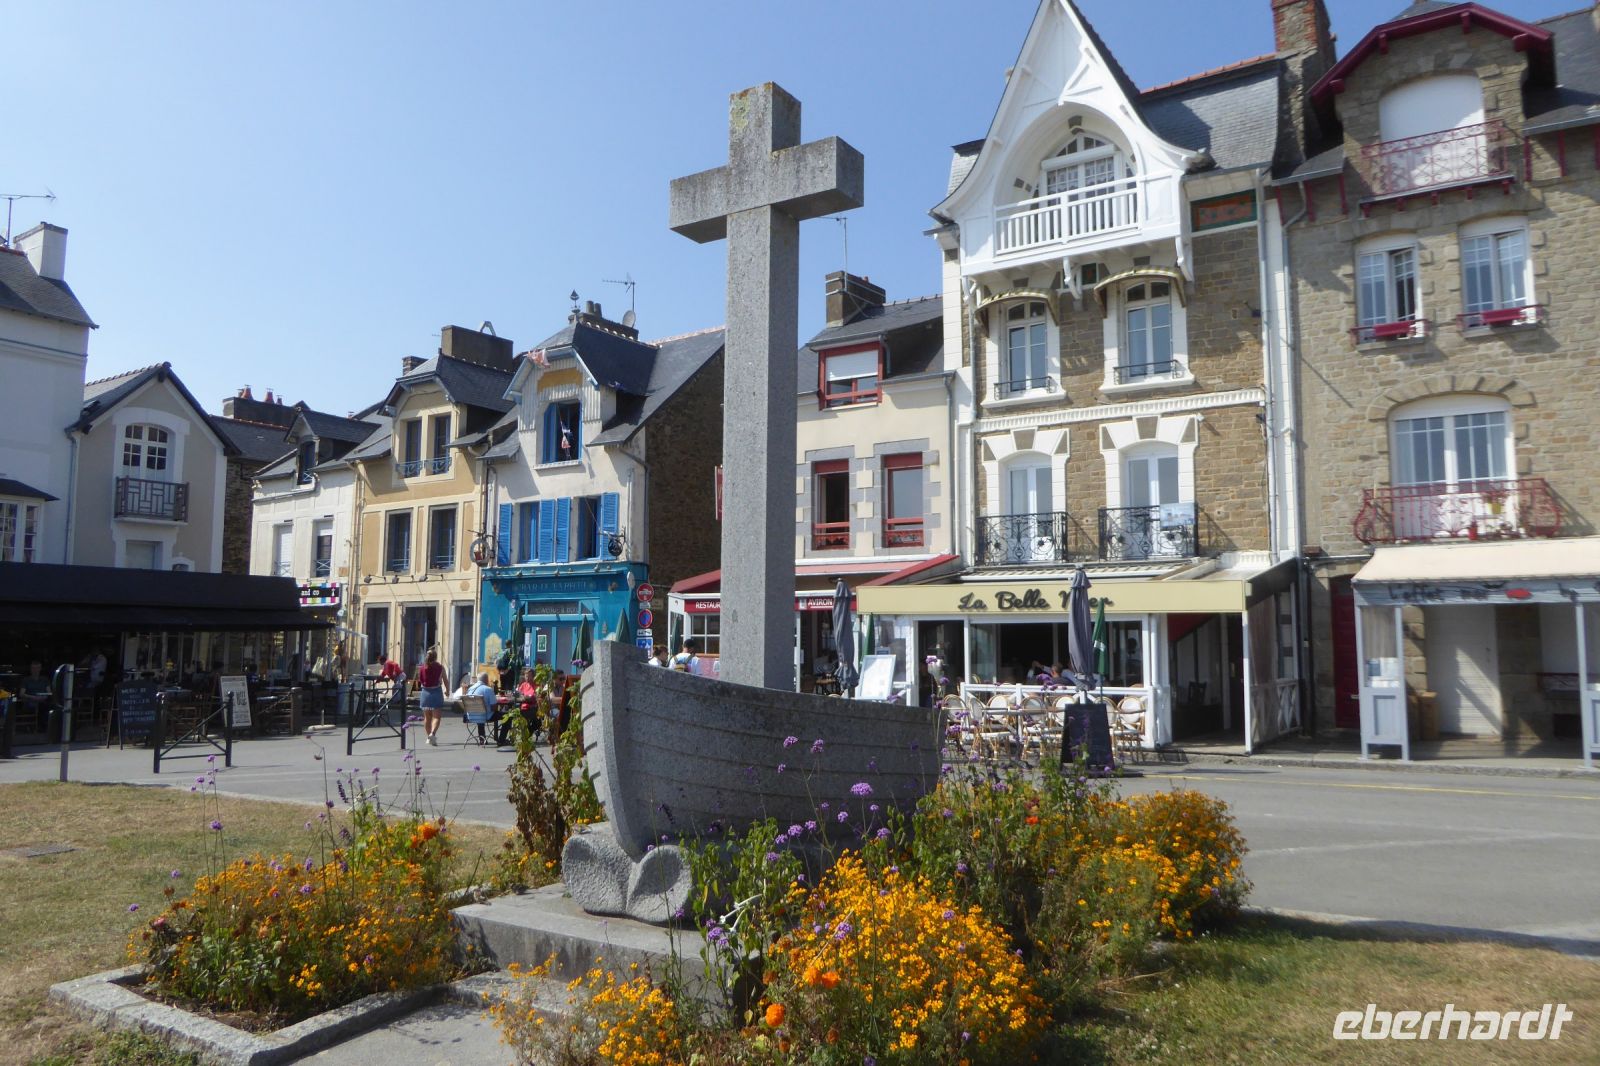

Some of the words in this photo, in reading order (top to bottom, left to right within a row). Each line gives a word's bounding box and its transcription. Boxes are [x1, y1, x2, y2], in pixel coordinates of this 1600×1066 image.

[301, 588, 311, 596] and
[808, 598, 833, 606] AVIRON
[957, 591, 987, 610] La
[995, 588, 1050, 610] Belle
